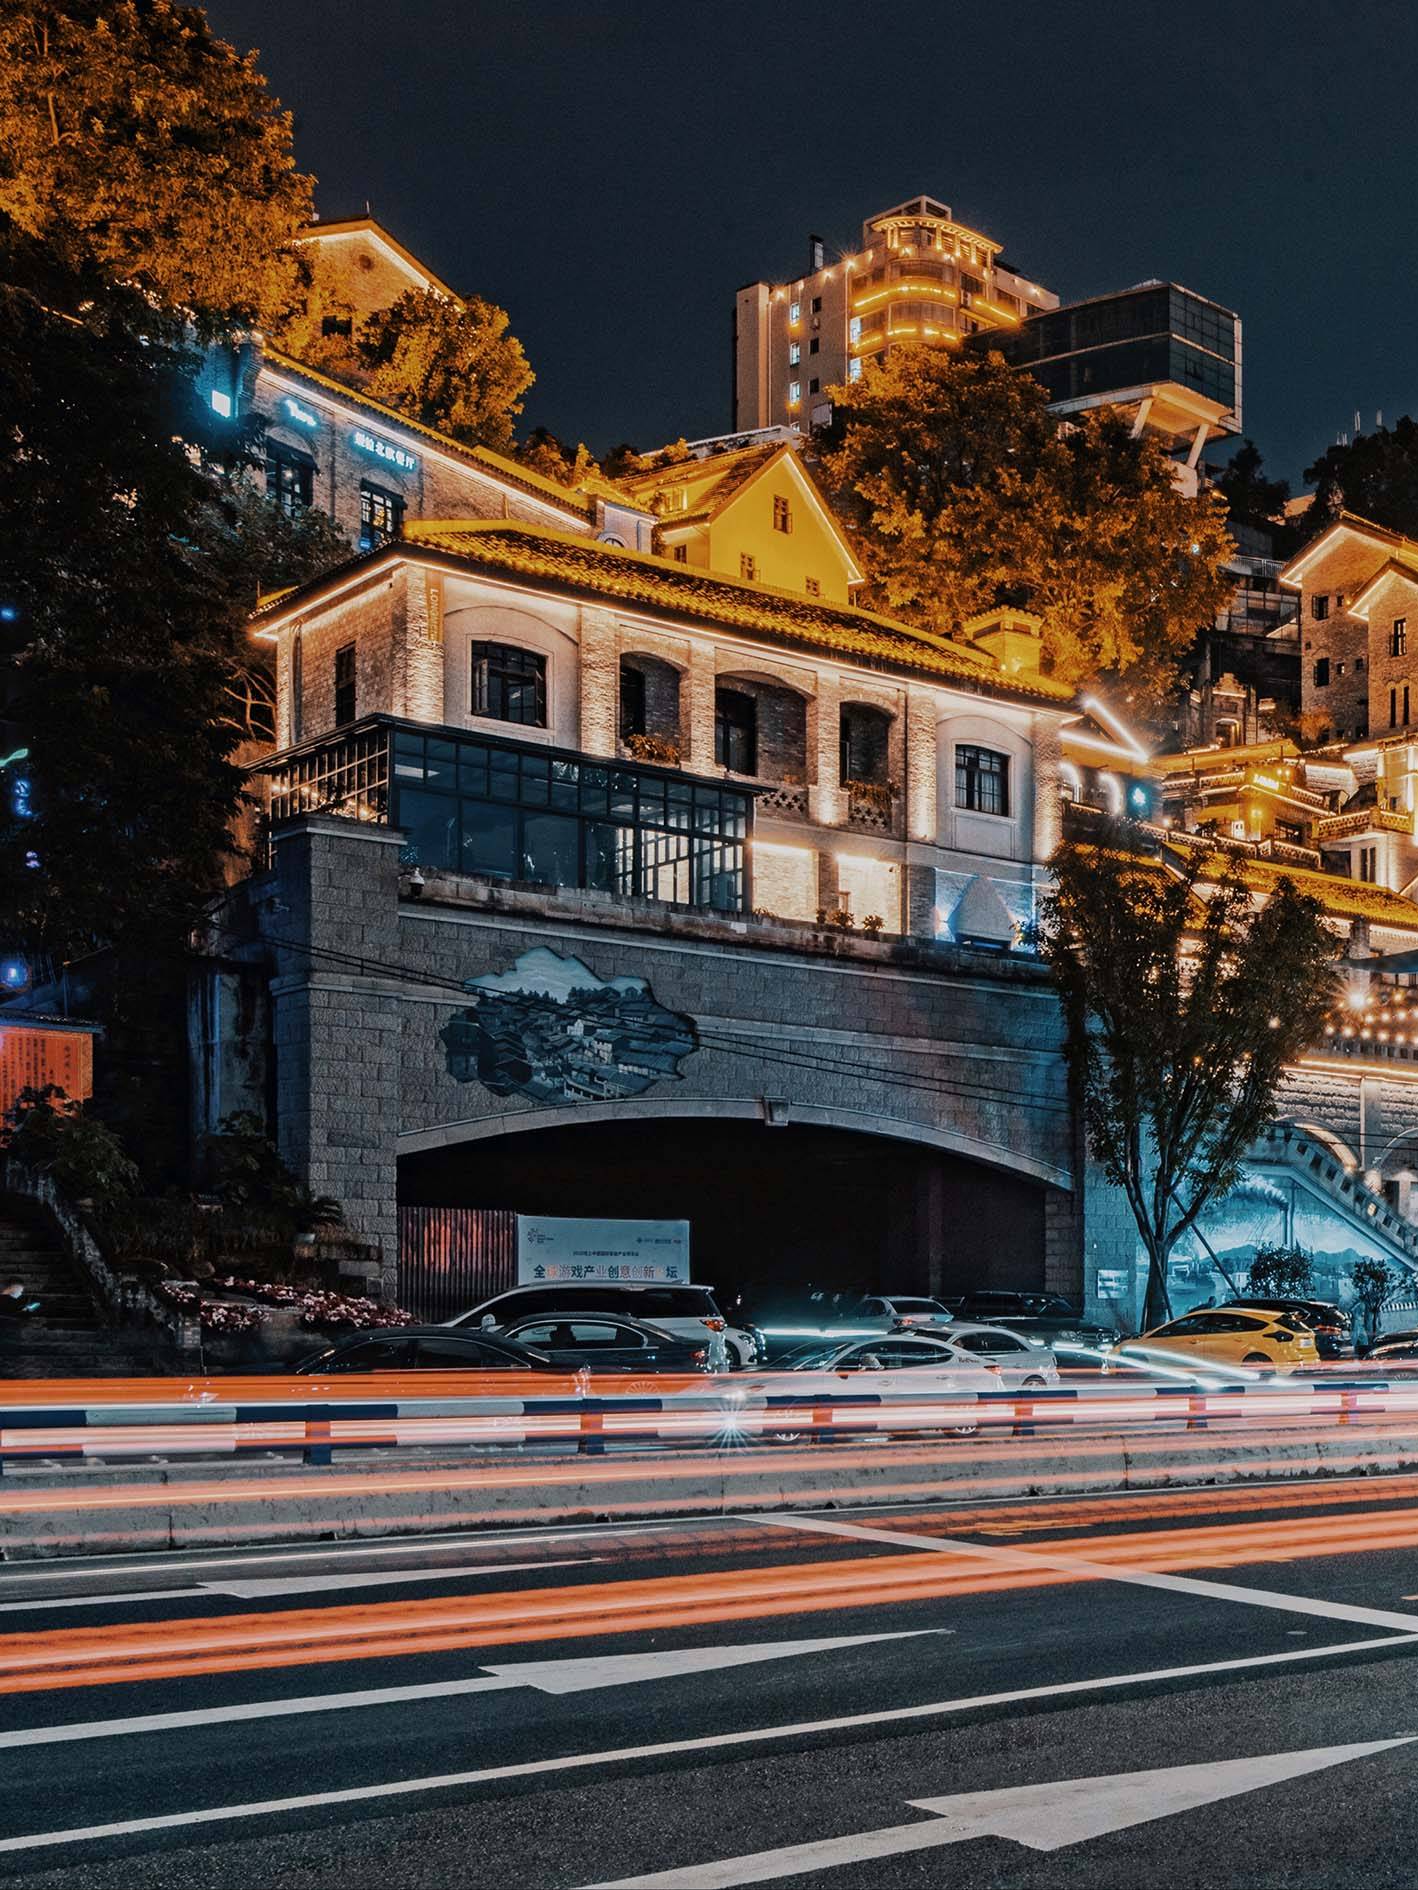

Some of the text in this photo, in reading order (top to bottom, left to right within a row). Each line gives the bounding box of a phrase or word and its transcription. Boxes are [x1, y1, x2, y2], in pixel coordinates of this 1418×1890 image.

[533, 1264, 678, 1279] 全球游戏产业创意创新坛
